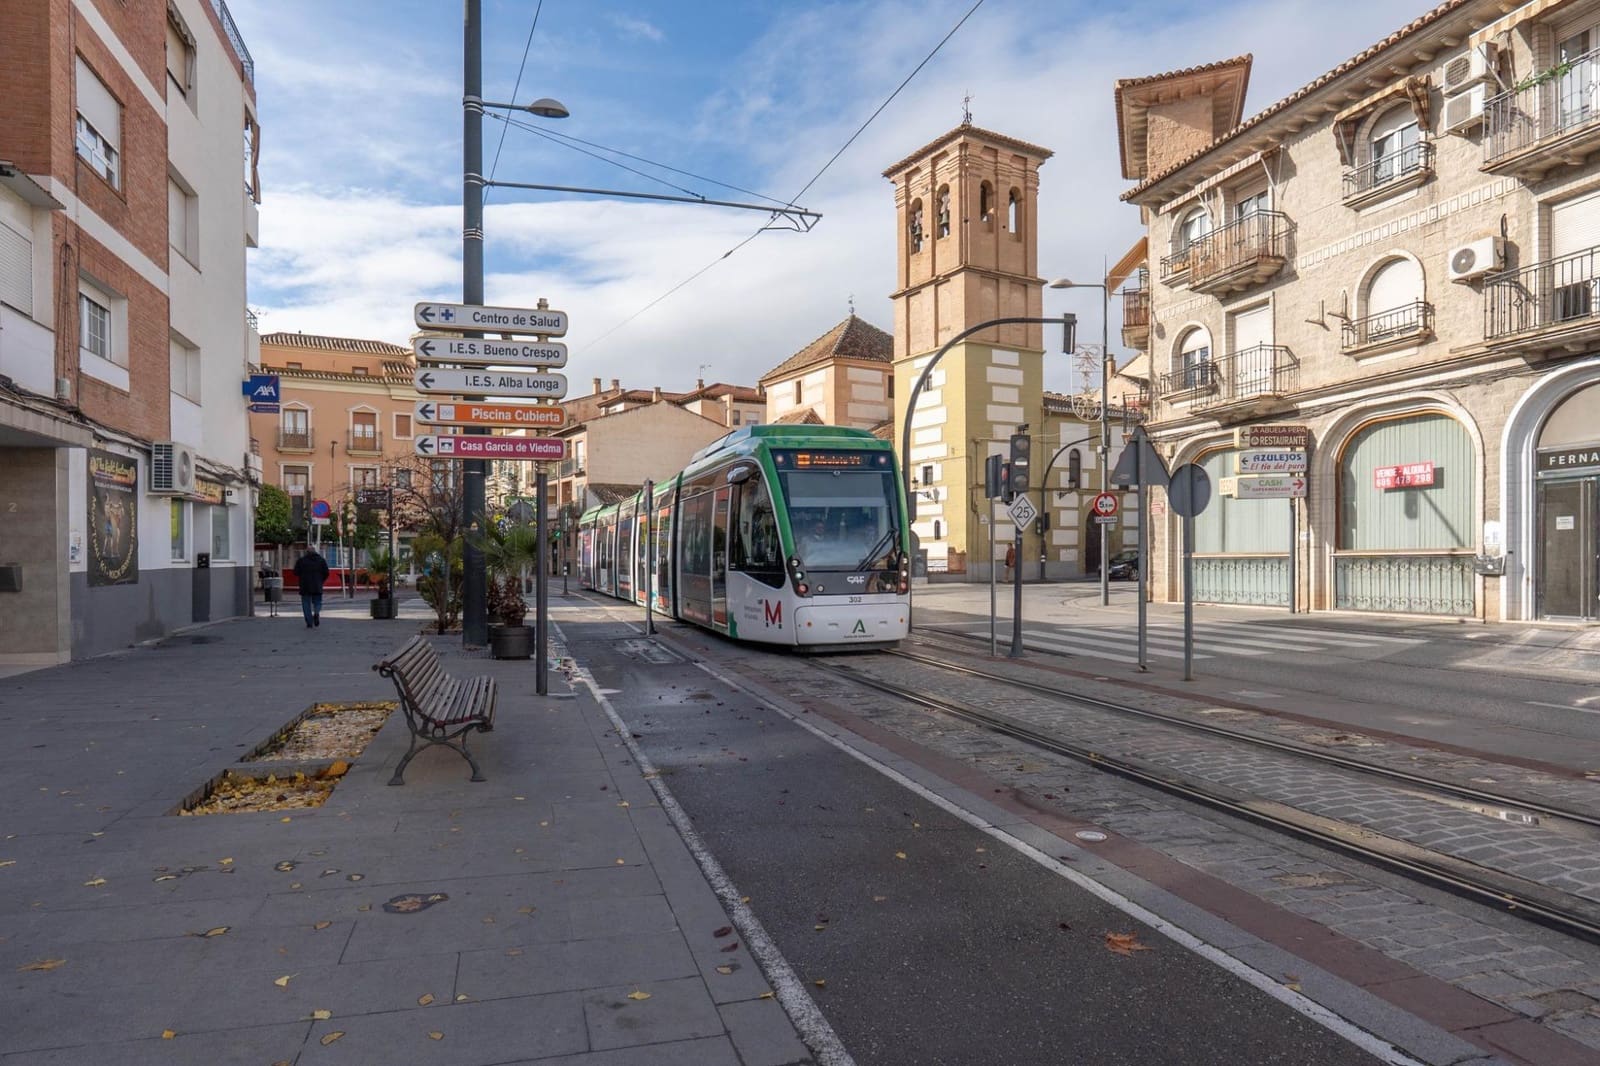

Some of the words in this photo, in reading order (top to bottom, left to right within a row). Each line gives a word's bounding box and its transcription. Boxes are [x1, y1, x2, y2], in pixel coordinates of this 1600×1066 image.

[472, 311, 509, 325] Centro
[512, 314, 526, 326] de
[529, 315, 560, 328] Salud
[449, 343, 480, 355] I.E.S.
[484, 344, 519, 357] Bueno
[522, 346, 560, 361] Crespo
[465, 375, 495, 388] I.E.S.
[498, 376, 523, 389] Alba
[526, 377, 559, 391] Longa
[253, 385, 276, 397] AXA
[471, 408, 511, 421] Piscina
[514, 409, 560, 423] Cubierta
[460, 440, 482, 451] Casa
[485, 440, 514, 453] García
[515, 441, 527, 452] de
[529, 442, 561, 454] Viedma
[1260, 436, 1306, 446] RESTAURANTE
[1253, 453, 1302, 462] AZULEJOS
[1549, 452, 1600, 466] FERNA
[1274, 462, 1286, 470] del
[1287, 463, 1305, 471] puro
[8, 502, 17, 513] 2
[1017, 506, 1030, 519] 25
